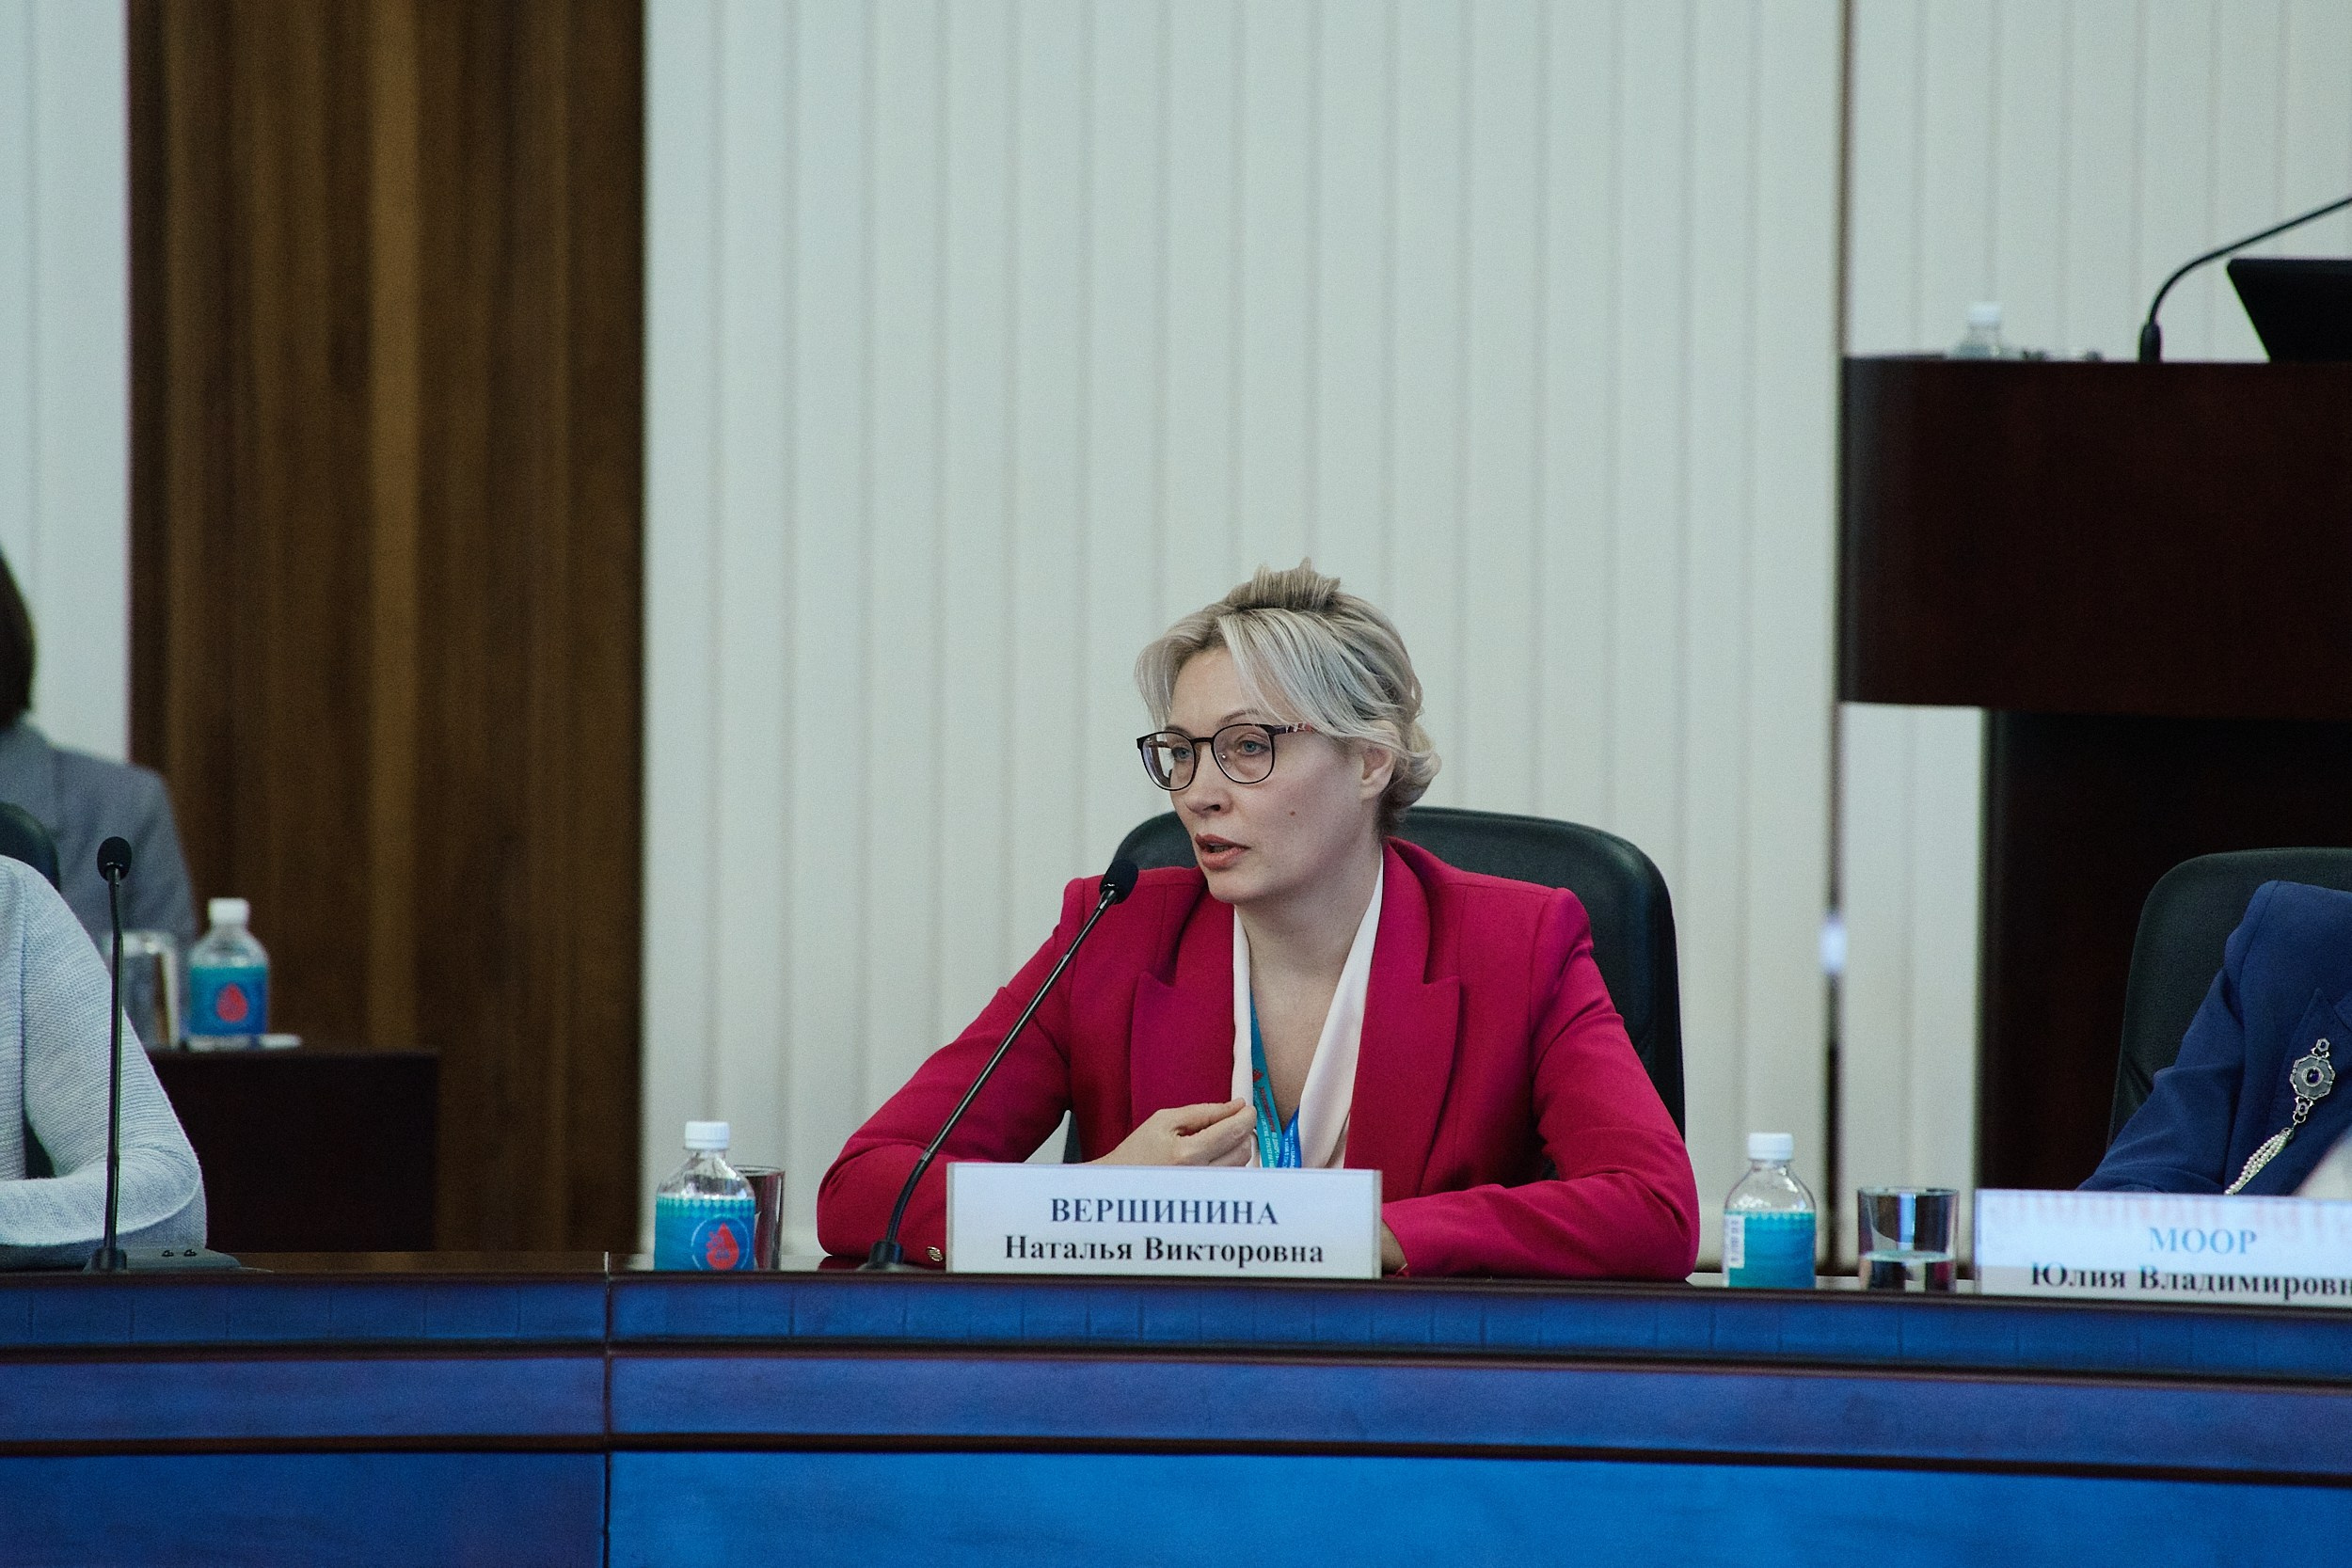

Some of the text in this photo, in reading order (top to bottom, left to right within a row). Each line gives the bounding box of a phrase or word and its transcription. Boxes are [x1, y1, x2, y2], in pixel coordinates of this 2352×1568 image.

[1050, 1197, 1279, 1225] ВЕРШИНИНА
[1006, 1234, 1325, 1269] Наталья Викторовна
[2149, 1227, 2258, 1255] МООР
[2031, 1261, 2126, 1288] Юлия
